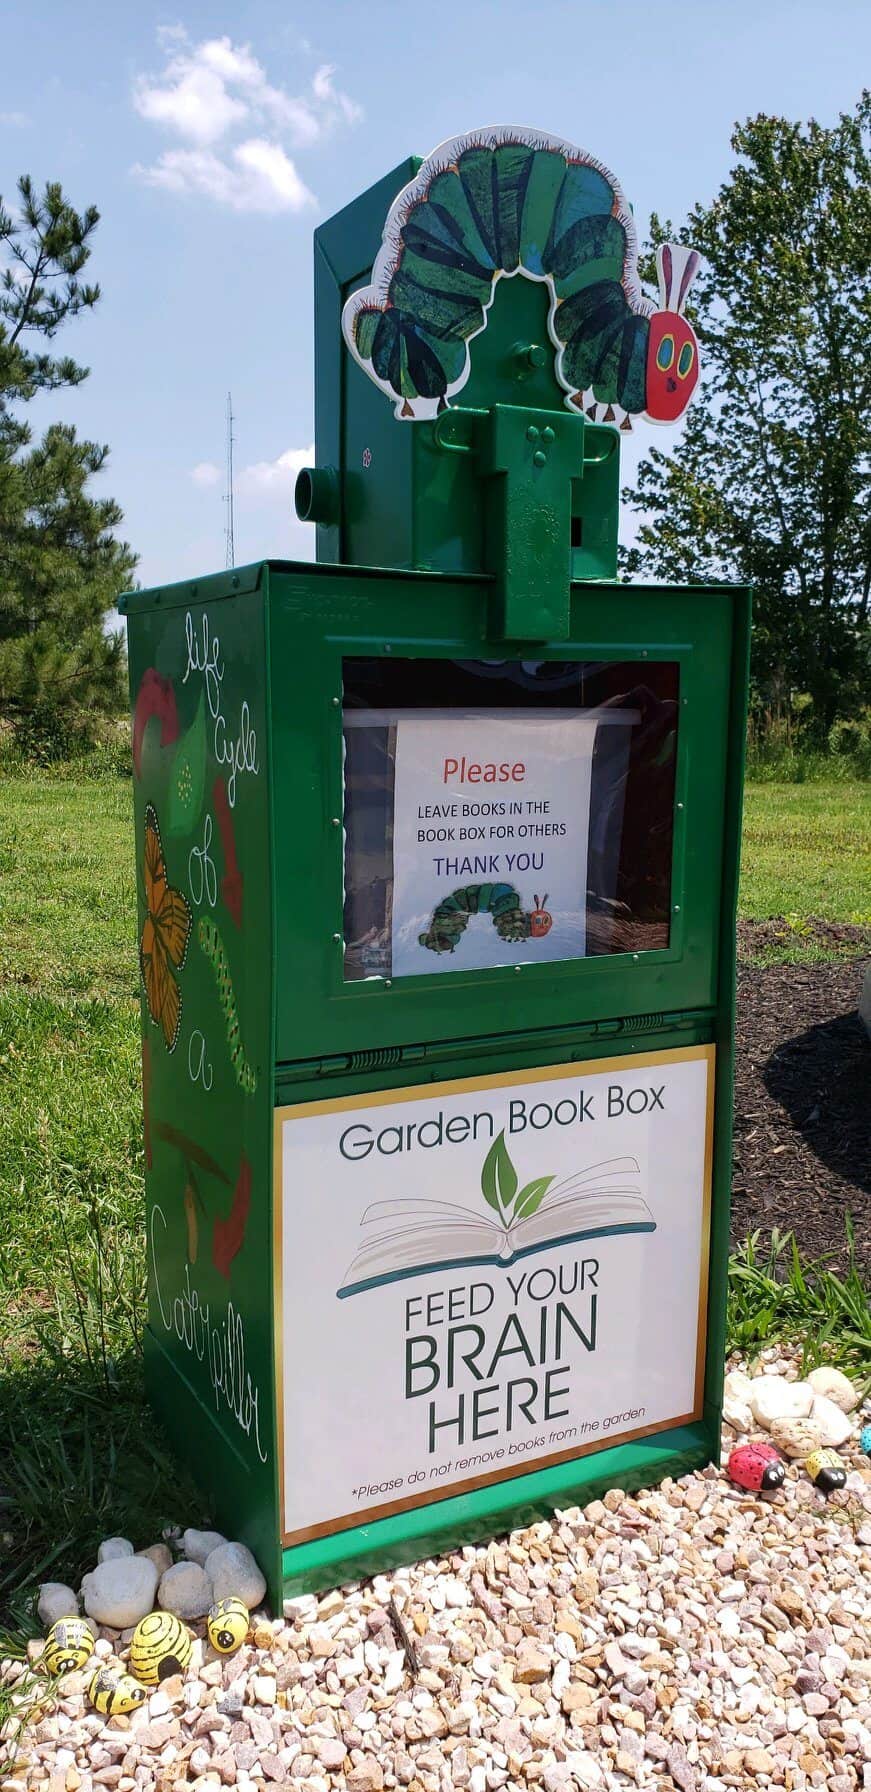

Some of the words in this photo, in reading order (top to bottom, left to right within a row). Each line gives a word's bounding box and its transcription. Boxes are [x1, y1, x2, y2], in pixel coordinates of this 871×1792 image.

[443, 757, 526, 784] Please
[417, 828, 455, 842] BOOK
[459, 826, 486, 840] BOX
[490, 825, 514, 838] FOR
[518, 823, 567, 837] OTHERS
[418, 804, 458, 819] LEAVE
[462, 802, 506, 817] BOOKS
[509, 801, 522, 815] IN
[526, 801, 551, 814] THE
[433, 855, 499, 876] THANK
[505, 852, 545, 872] YOU
[189, 1029, 213, 1090] a
[339, 1111, 494, 1161] Garden
[509, 1090, 595, 1134] Book
[607, 1085, 666, 1118] Box
[405, 1282, 495, 1331] FEED
[506, 1258, 600, 1306] YOUR
[405, 1294, 598, 1400] BRAIN
[428, 1366, 571, 1453] HERE
[407, 1470, 426, 1485] do
[429, 1463, 452, 1479] not
[455, 1447, 505, 1470] remove
[508, 1436, 545, 1456] books
[548, 1426, 578, 1444] from
[580, 1419, 600, 1434] the
[602, 1406, 647, 1430] garden
